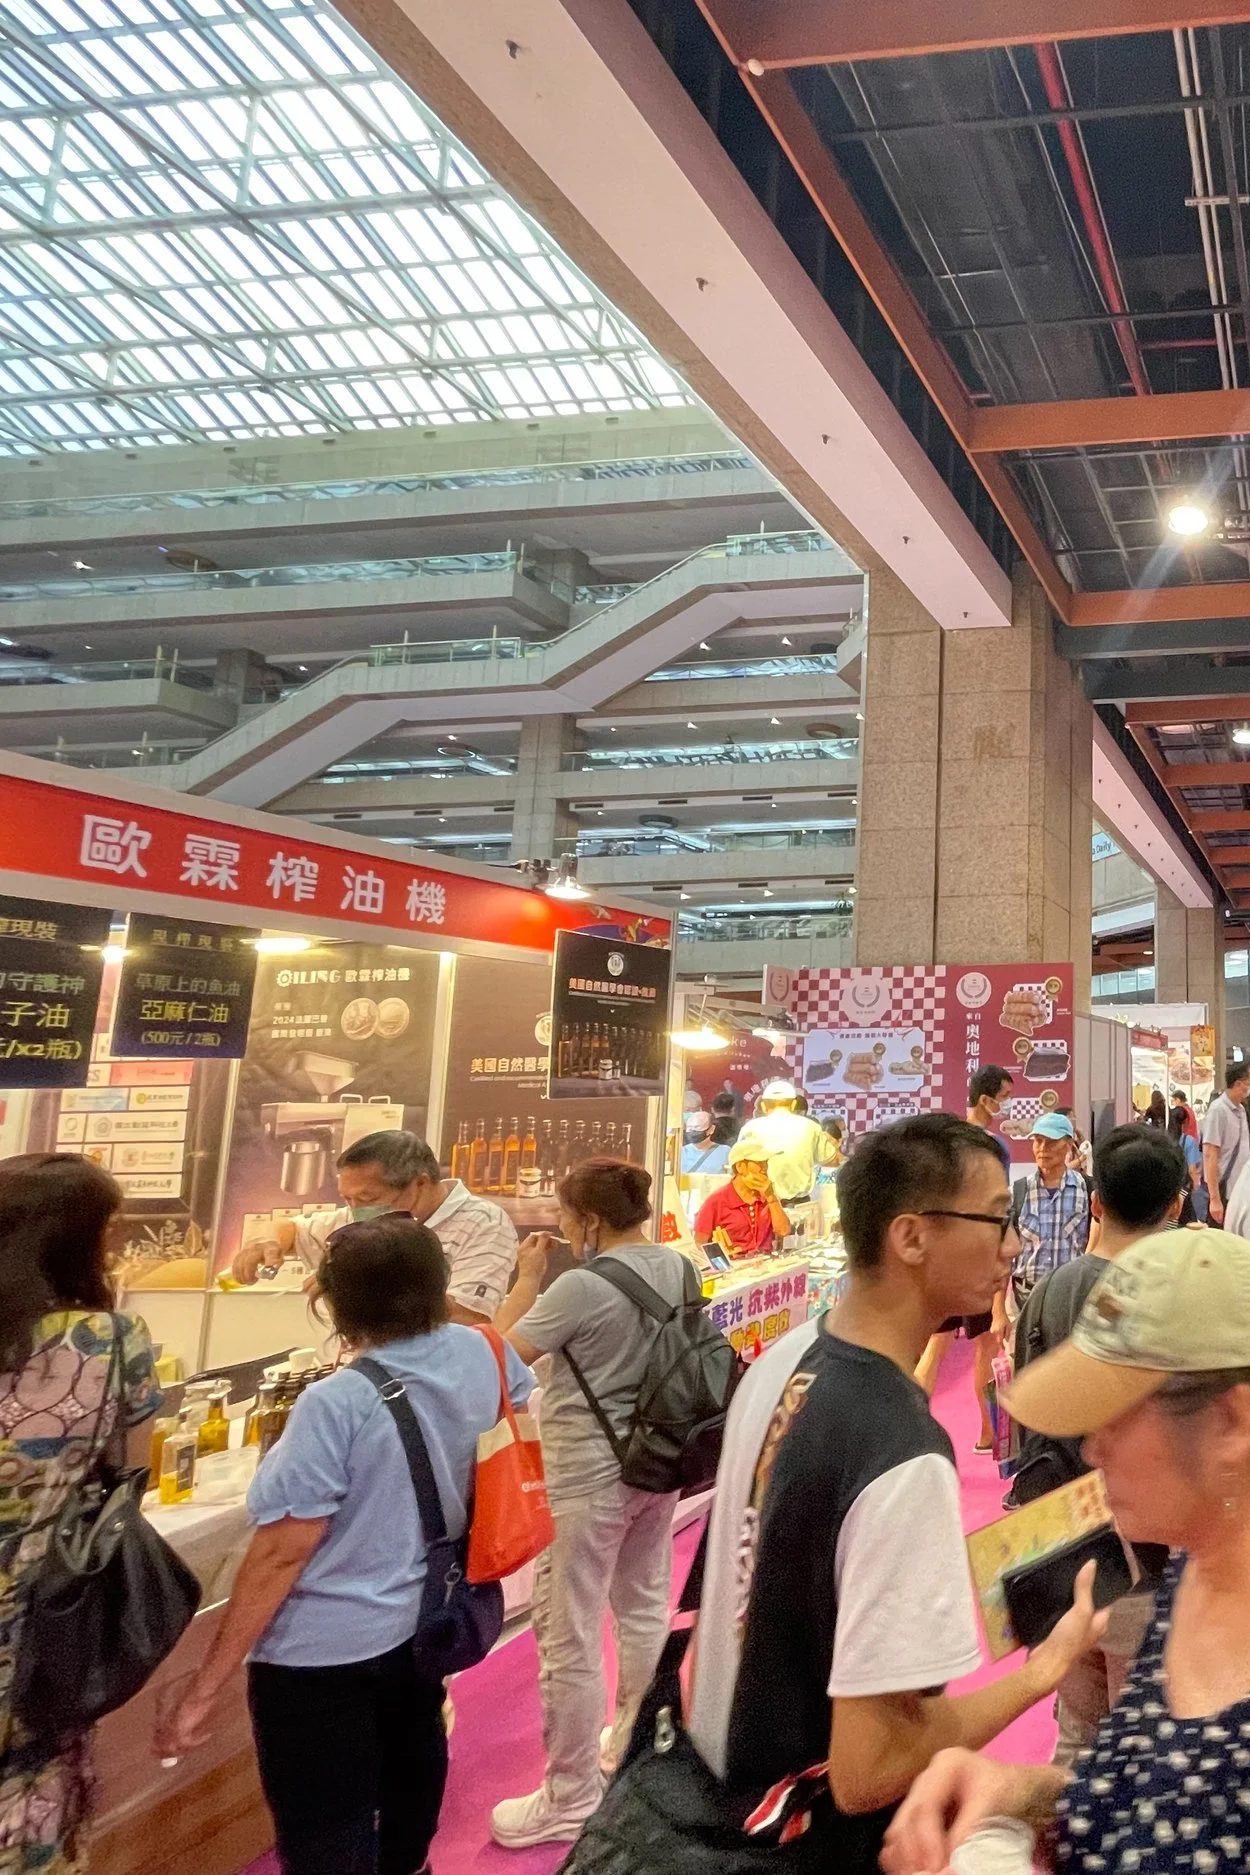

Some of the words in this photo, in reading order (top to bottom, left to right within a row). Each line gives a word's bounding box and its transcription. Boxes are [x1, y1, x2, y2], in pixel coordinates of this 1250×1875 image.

[80, 814, 447, 925] 歐霖榨油機
[140, 999, 229, 1025] 亞麻仁油
[706, 1295, 743, 1331] 藍光
